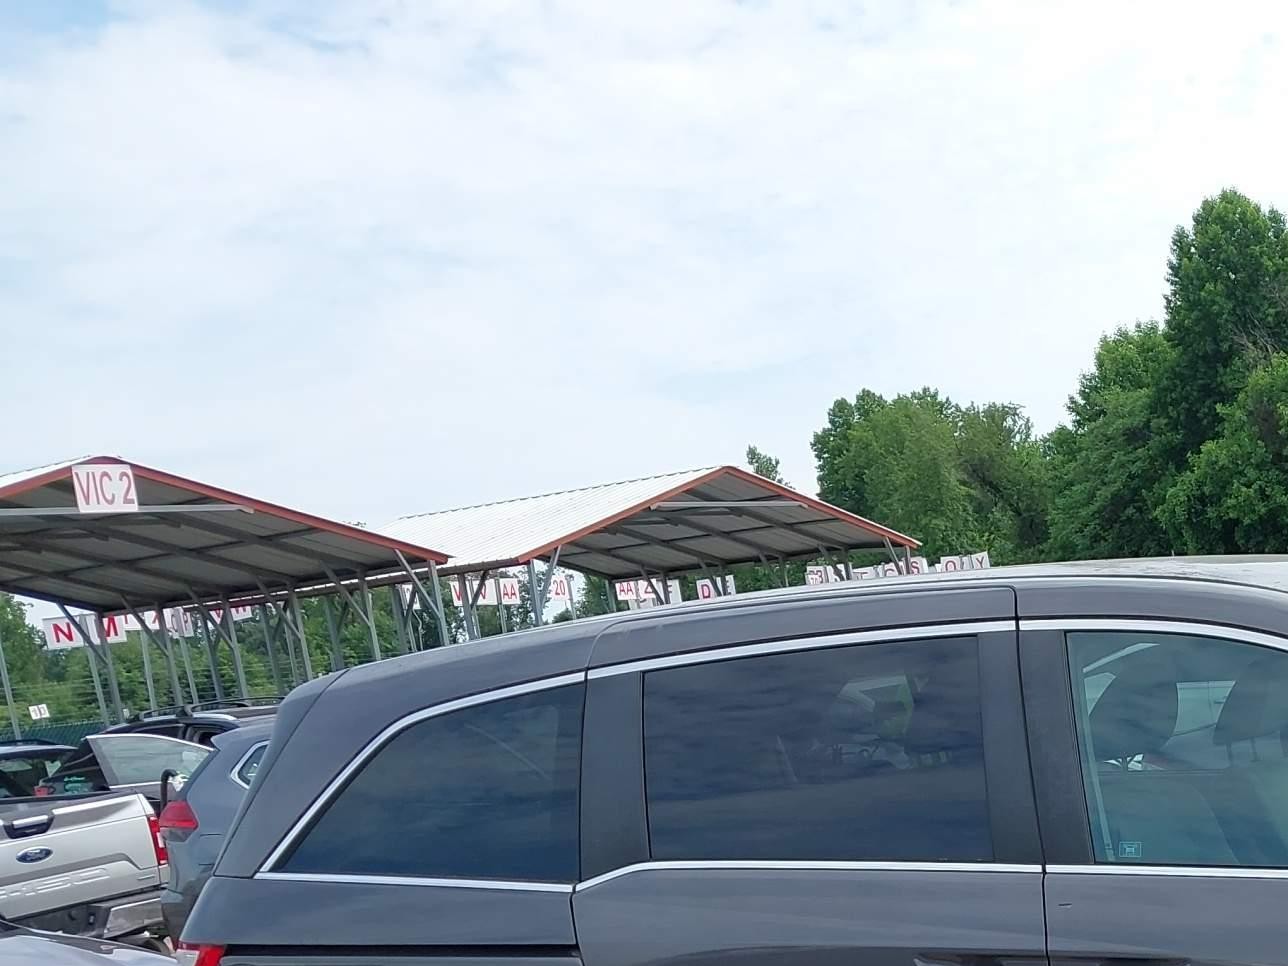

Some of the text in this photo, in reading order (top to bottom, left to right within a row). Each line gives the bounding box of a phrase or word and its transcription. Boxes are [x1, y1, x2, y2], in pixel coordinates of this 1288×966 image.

[74, 471, 135, 506] VIC 2
[503, 583, 518, 600] AA
[553, 580, 566, 596] 20
[619, 583, 634, 596] AA
[702, 583, 711, 599] D
[52, 622, 73, 642] N
